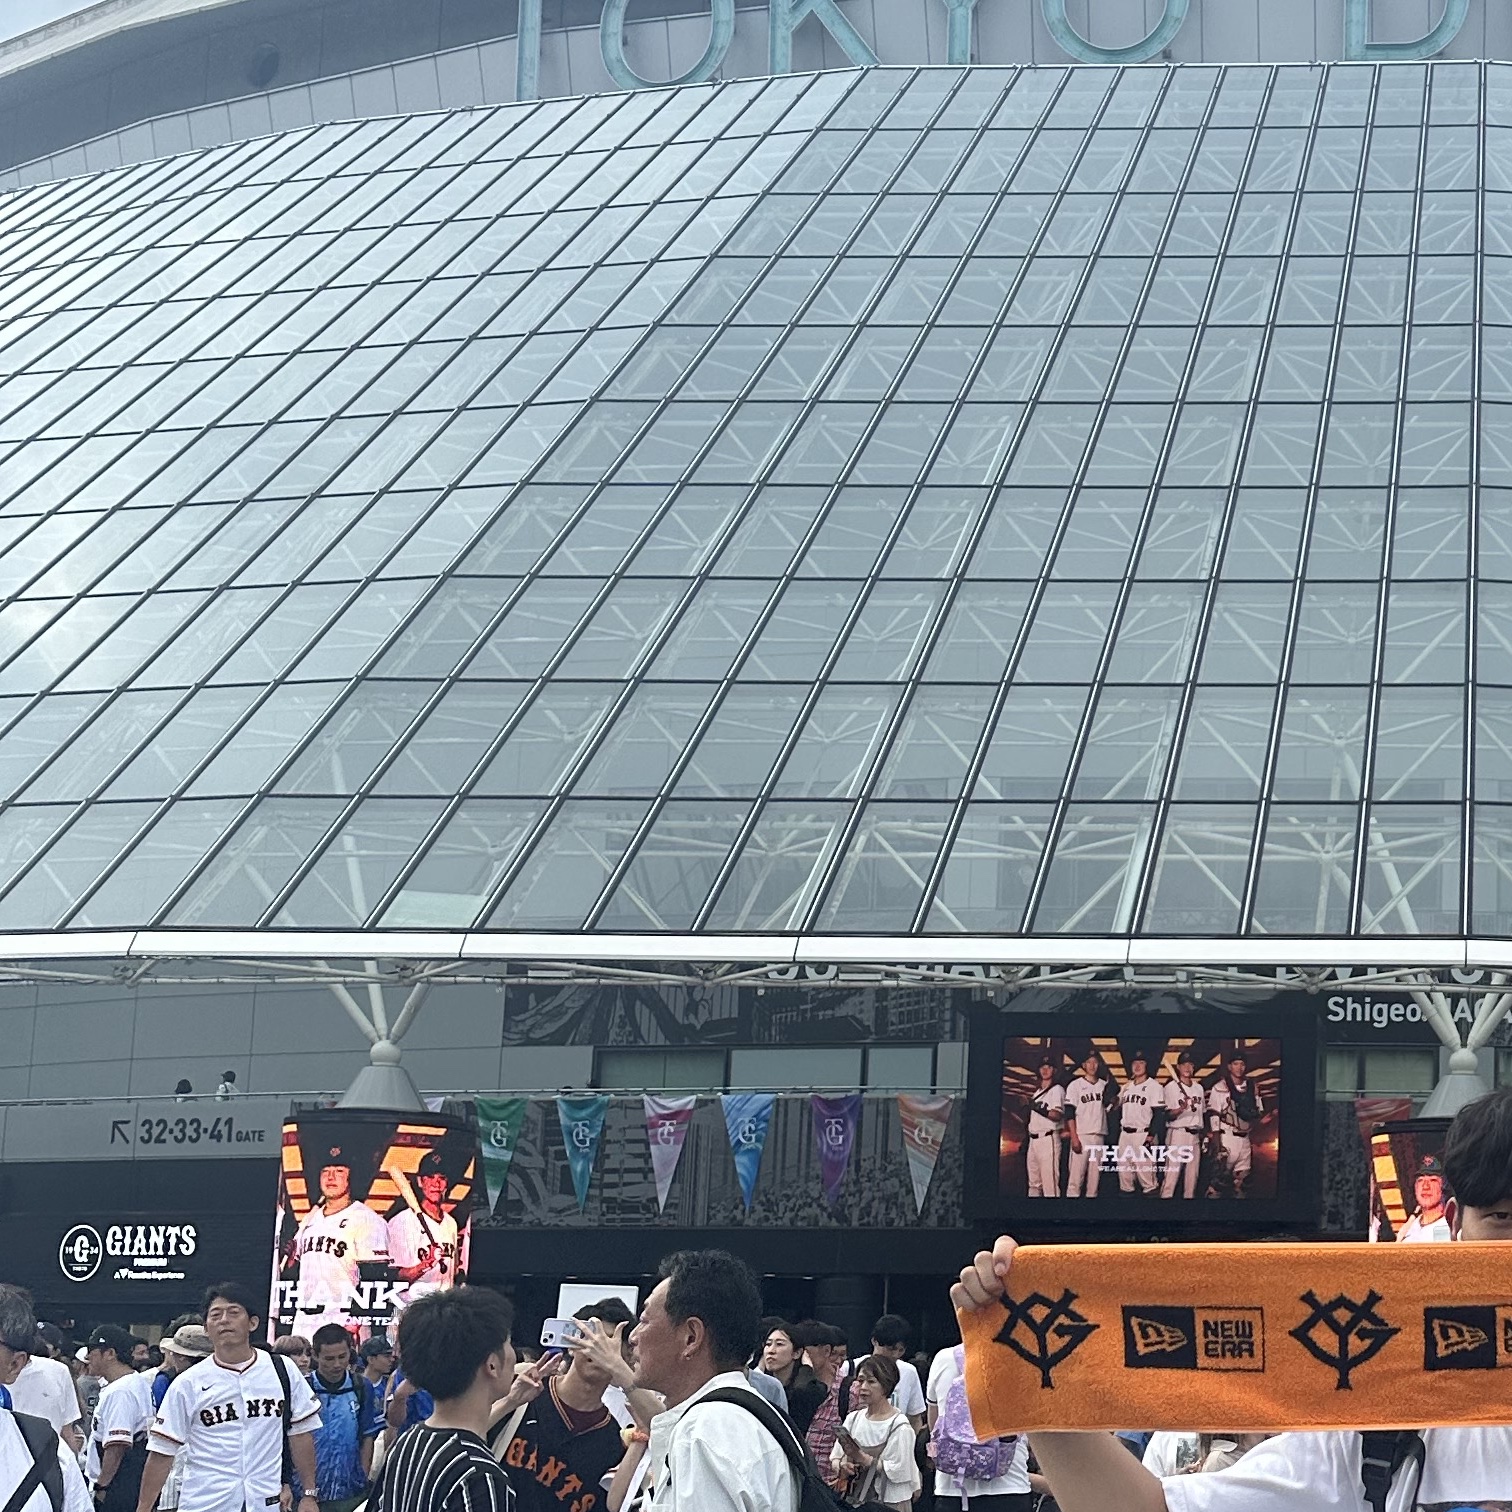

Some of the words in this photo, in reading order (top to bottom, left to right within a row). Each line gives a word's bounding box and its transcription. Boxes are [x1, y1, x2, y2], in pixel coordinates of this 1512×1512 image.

[1326, 996, 1421, 1028] Shigeo
[236, 1130, 265, 1142] GATE
[1085, 1145, 1194, 1163] THANKS
[105, 1225, 196, 1256] GIANTS
[1202, 1319, 1254, 1339] NEW
[1203, 1340, 1255, 1359] ERA
[200, 1398, 286, 1427] GIANTS
